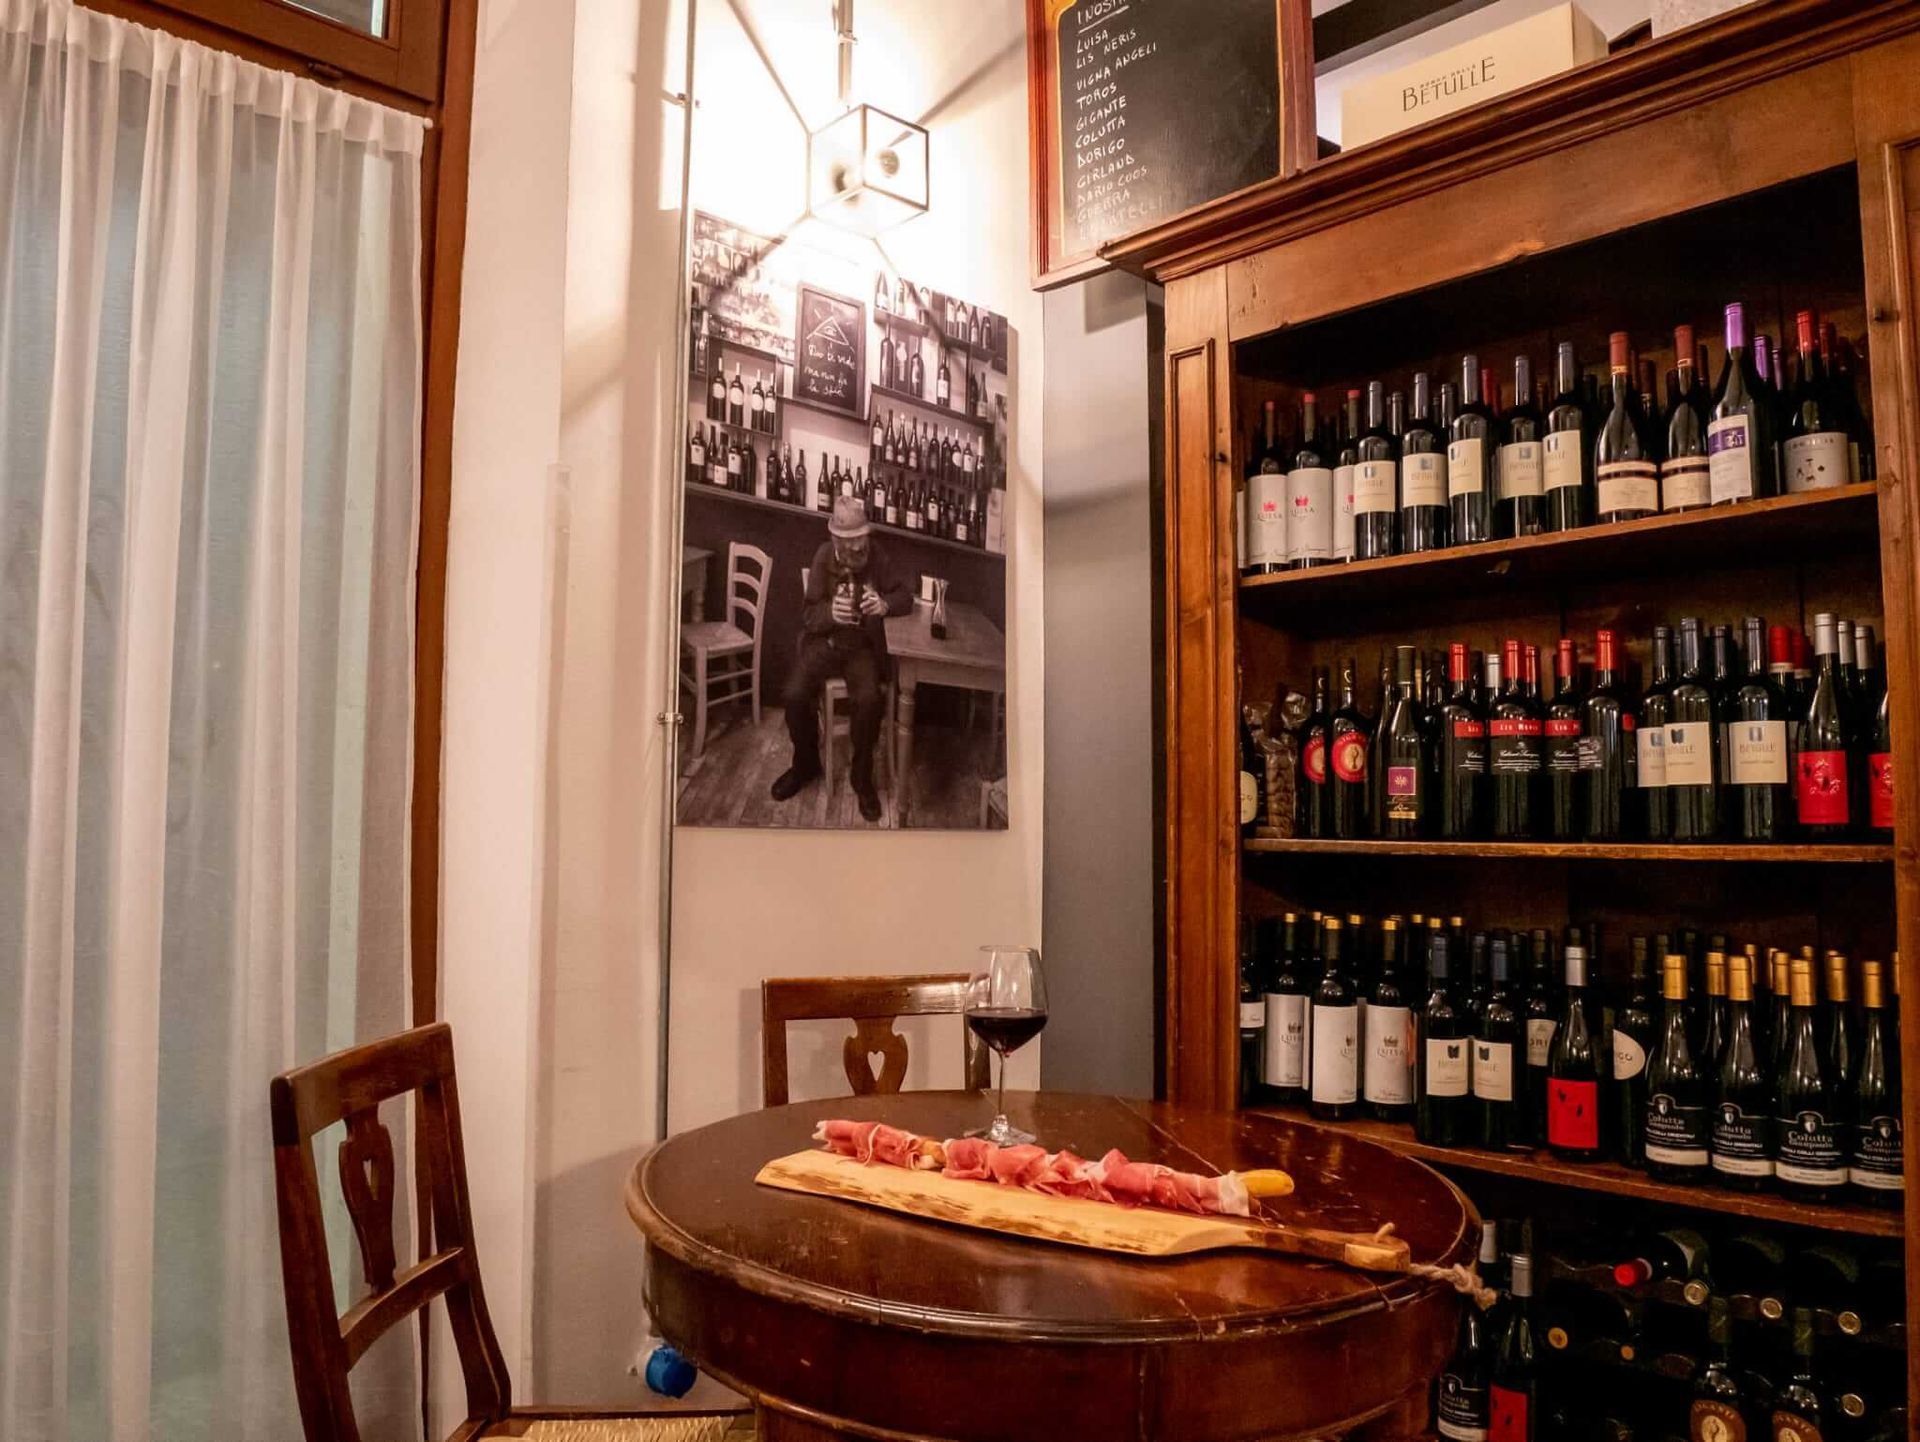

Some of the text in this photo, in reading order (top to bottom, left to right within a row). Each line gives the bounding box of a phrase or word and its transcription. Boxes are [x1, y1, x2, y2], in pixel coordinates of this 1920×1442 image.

[1076, 28, 1137, 69] LIS NERIS
[1077, 29, 1109, 54] LUISA
[1076, 41, 1156, 91] VIGNA ANGELI
[1077, 82, 1117, 110] TOROS
[1402, 56, 1496, 112] BETULLE
[1076, 95, 1127, 131] GIGANTE
[1075, 115, 1126, 149] COLUTTA
[1077, 138, 1125, 168] DORIGO
[1077, 181, 1113, 208] DARIO
[1787, 1130, 1834, 1144] Colutta
